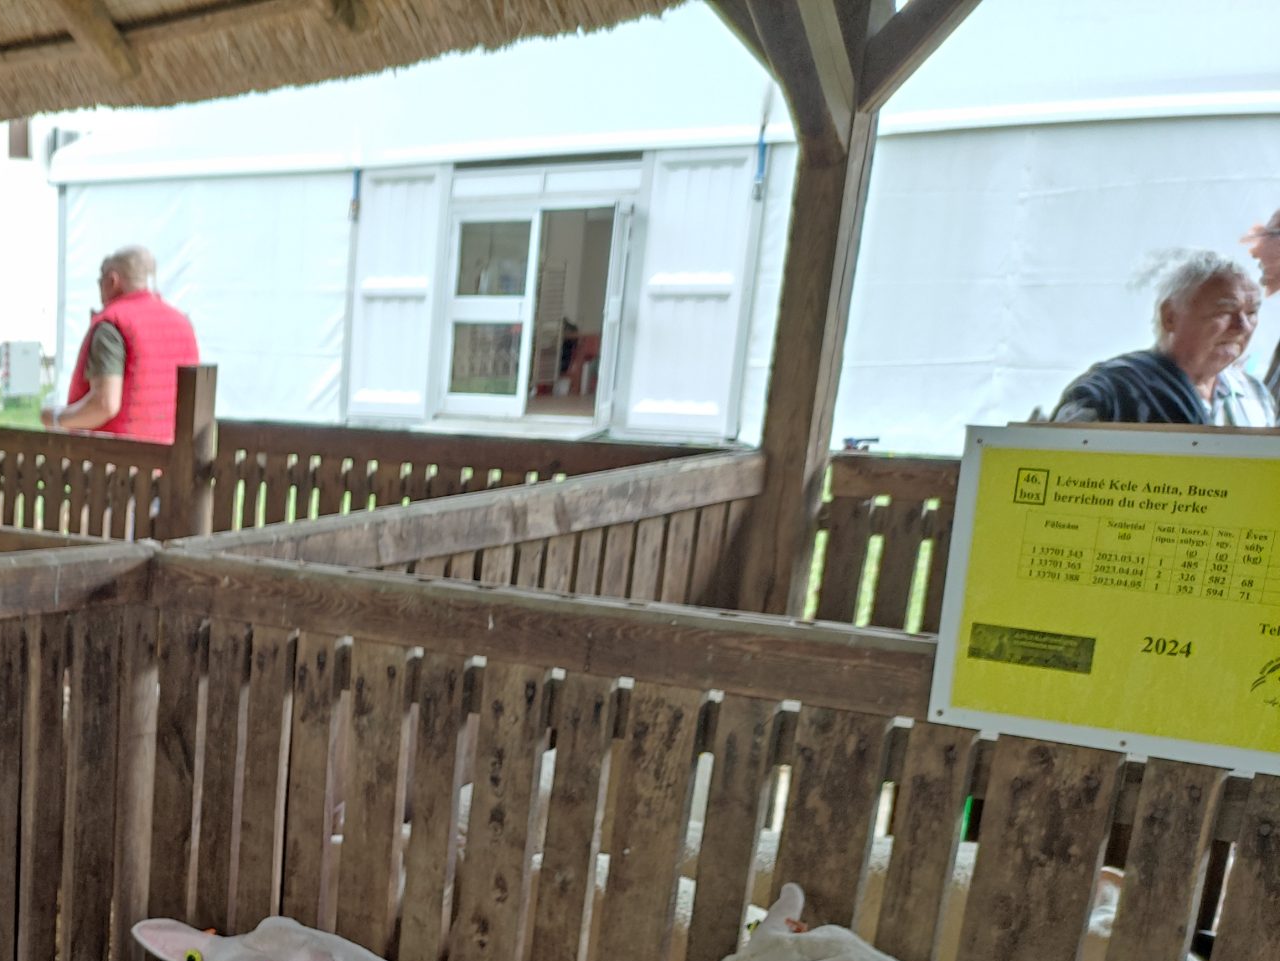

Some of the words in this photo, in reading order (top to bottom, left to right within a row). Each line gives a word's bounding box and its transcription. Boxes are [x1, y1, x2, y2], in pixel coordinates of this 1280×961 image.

[1023, 473, 1041, 485] 46.
[1056, 476, 1106, 490] Lévainé
[1109, 479, 1138, 493] Kele
[1143, 482, 1183, 497] Anita,
[1187, 485, 1229, 498] Bucsa
[1019, 488, 1041, 501] box
[1053, 493, 1115, 507] berrichon
[1118, 496, 1135, 508] du
[1138, 499, 1168, 512] cher
[1171, 500, 1209, 515] jerke
[1242, 554, 1262, 565] (kg)
[1241, 578, 1254, 588] 68
[1239, 591, 1250, 601] 71
[1141, 636, 1192, 658] 2024
